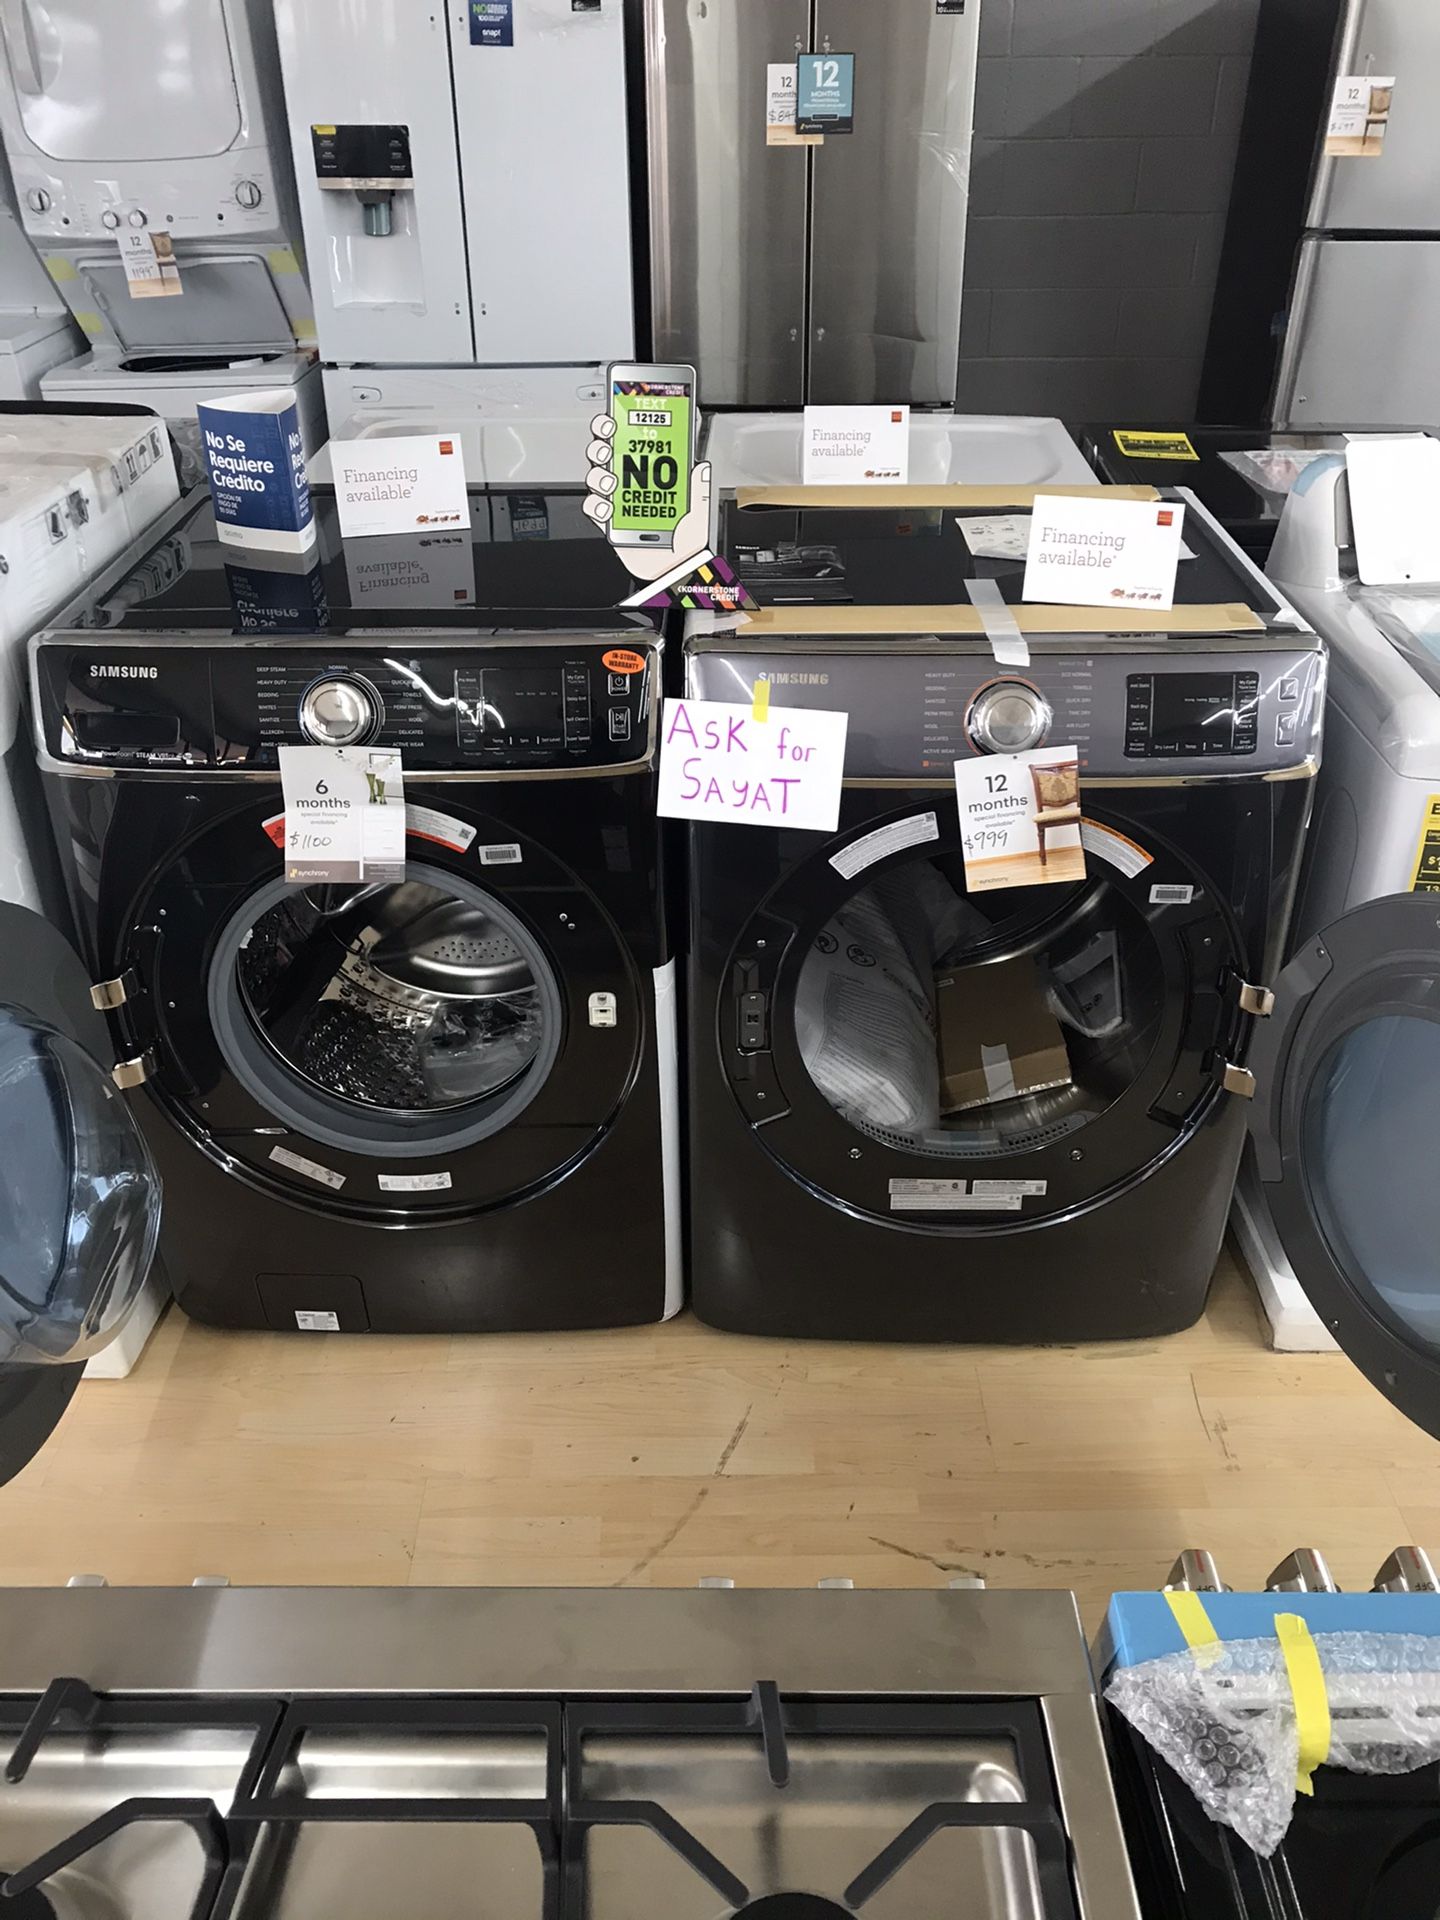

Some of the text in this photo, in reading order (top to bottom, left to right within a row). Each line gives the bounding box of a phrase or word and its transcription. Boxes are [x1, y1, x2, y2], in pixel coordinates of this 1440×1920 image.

[813, 61, 840, 88] 12
[781, 76, 792, 88] 12
[1348, 88, 1360, 100] 12
[130, 236, 142, 247] 12
[634, 398, 668, 410] TEXT
[635, 413, 666, 424] 12125
[642, 427, 658, 440] to
[812, 429, 871, 444] Financing
[205, 430, 246, 452] No Se
[628, 439, 672, 454] 37981
[208, 450, 275, 474] Requiere
[343, 467, 419, 484] Financing
[622, 454, 678, 490] NO
[212, 470, 266, 492] Crédito
[622, 490, 677, 505] CREDIT
[622, 505, 677, 518] NEEDED
[1041, 527, 1126, 551] Financing
[710, 594, 740, 602] CREDIT
[611, 652, 638, 661] IN-STORE
[90, 665, 158, 679] SAMSUNG
[608, 660, 639, 670] WARRANTY
[758, 671, 829, 685] SAMSUNG
[776, 727, 817, 763] for
[315, 779, 329, 795] 6
[984, 774, 1008, 793] 12
[296, 798, 351, 809] months
[968, 796, 1028, 813] months
[298, 869, 329, 878] synchrony
